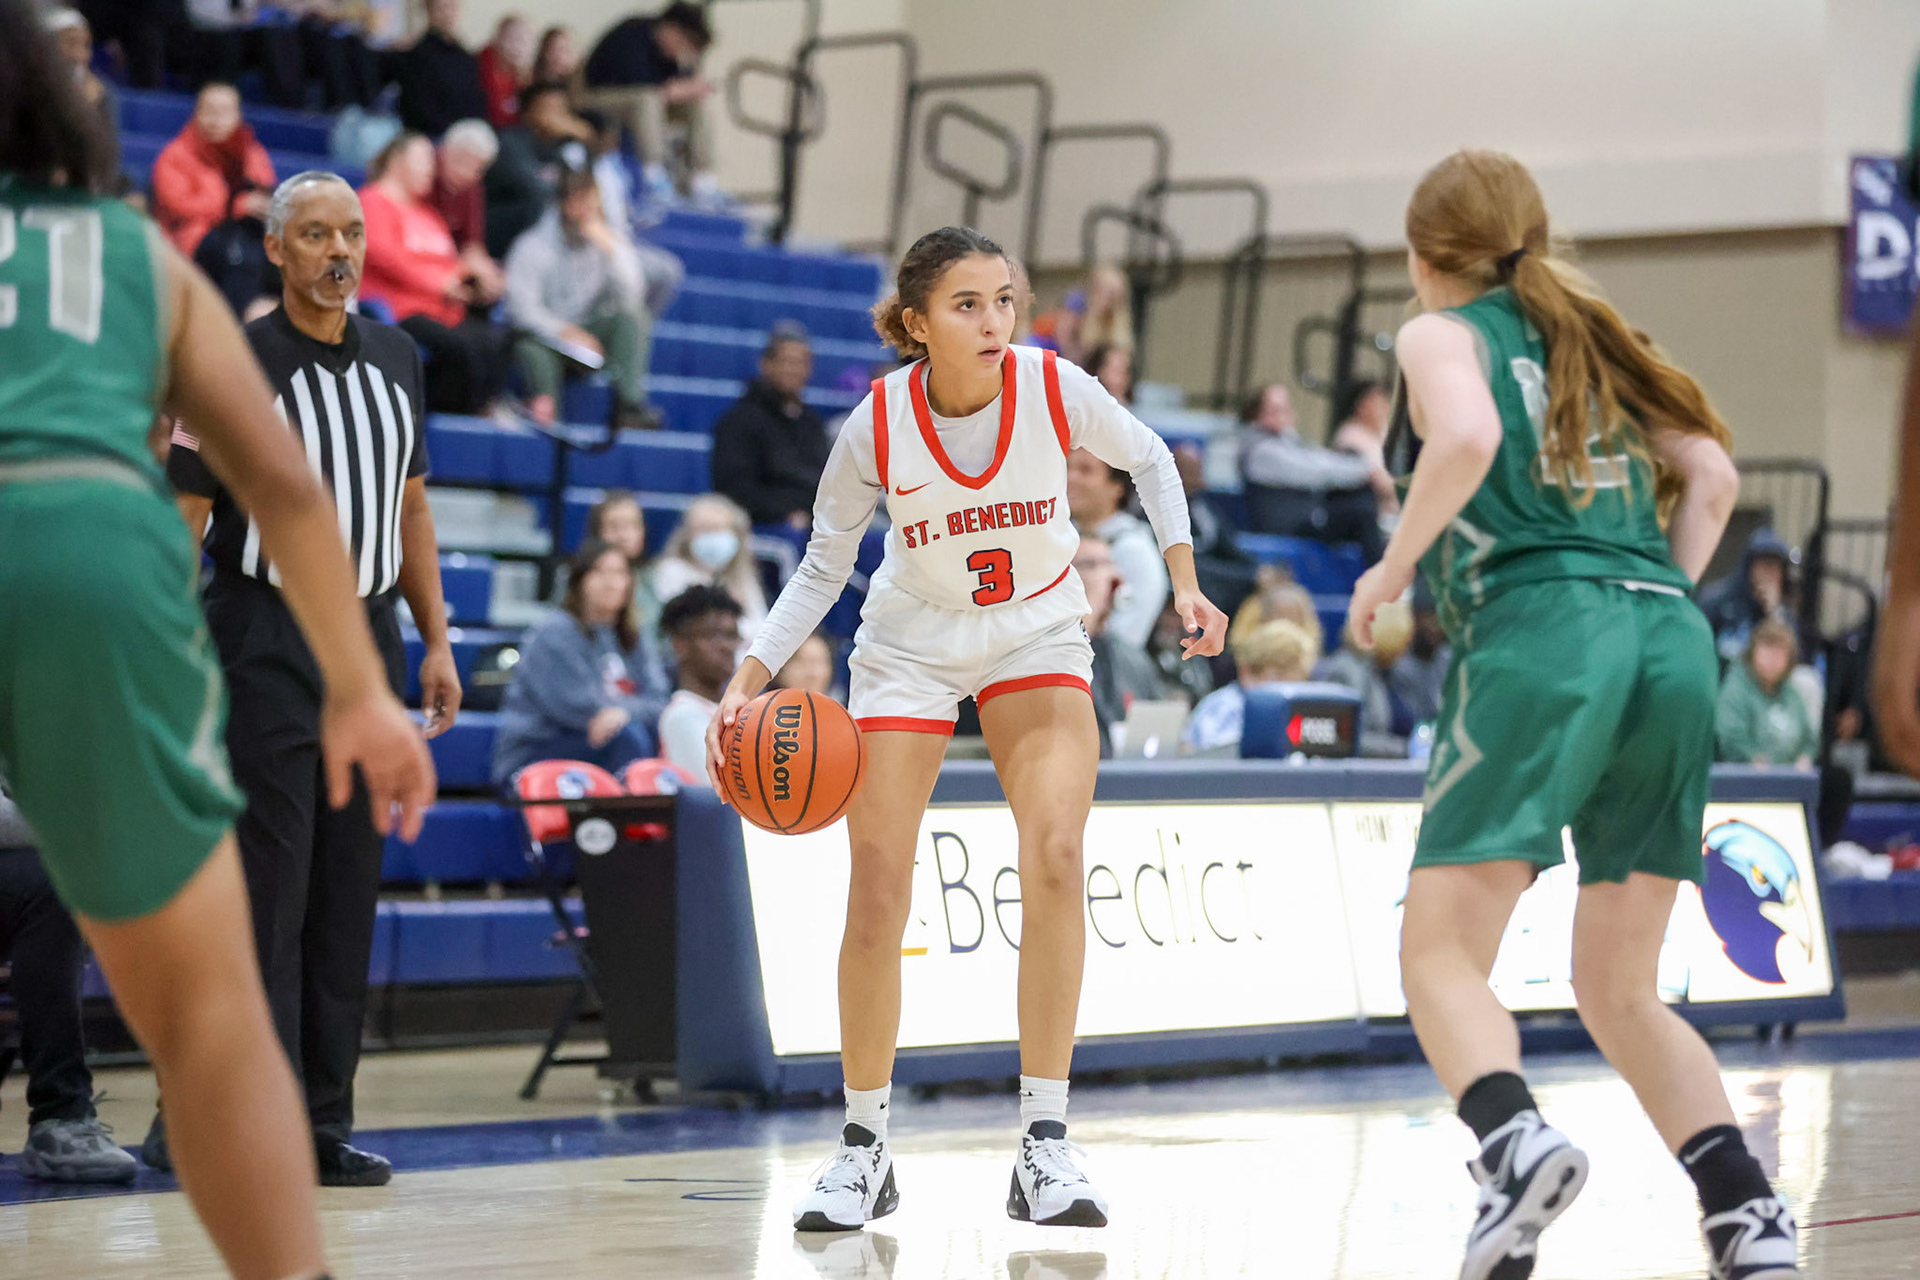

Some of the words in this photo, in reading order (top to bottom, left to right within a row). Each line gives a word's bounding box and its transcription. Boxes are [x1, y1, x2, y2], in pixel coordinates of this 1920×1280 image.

[902, 519, 941, 549] ST.
[946, 496, 1057, 537] BENEDICT
[966, 547, 1016, 607] 3
[772, 703, 803, 803] Wilson
[931, 828, 1263, 954] Beedict
